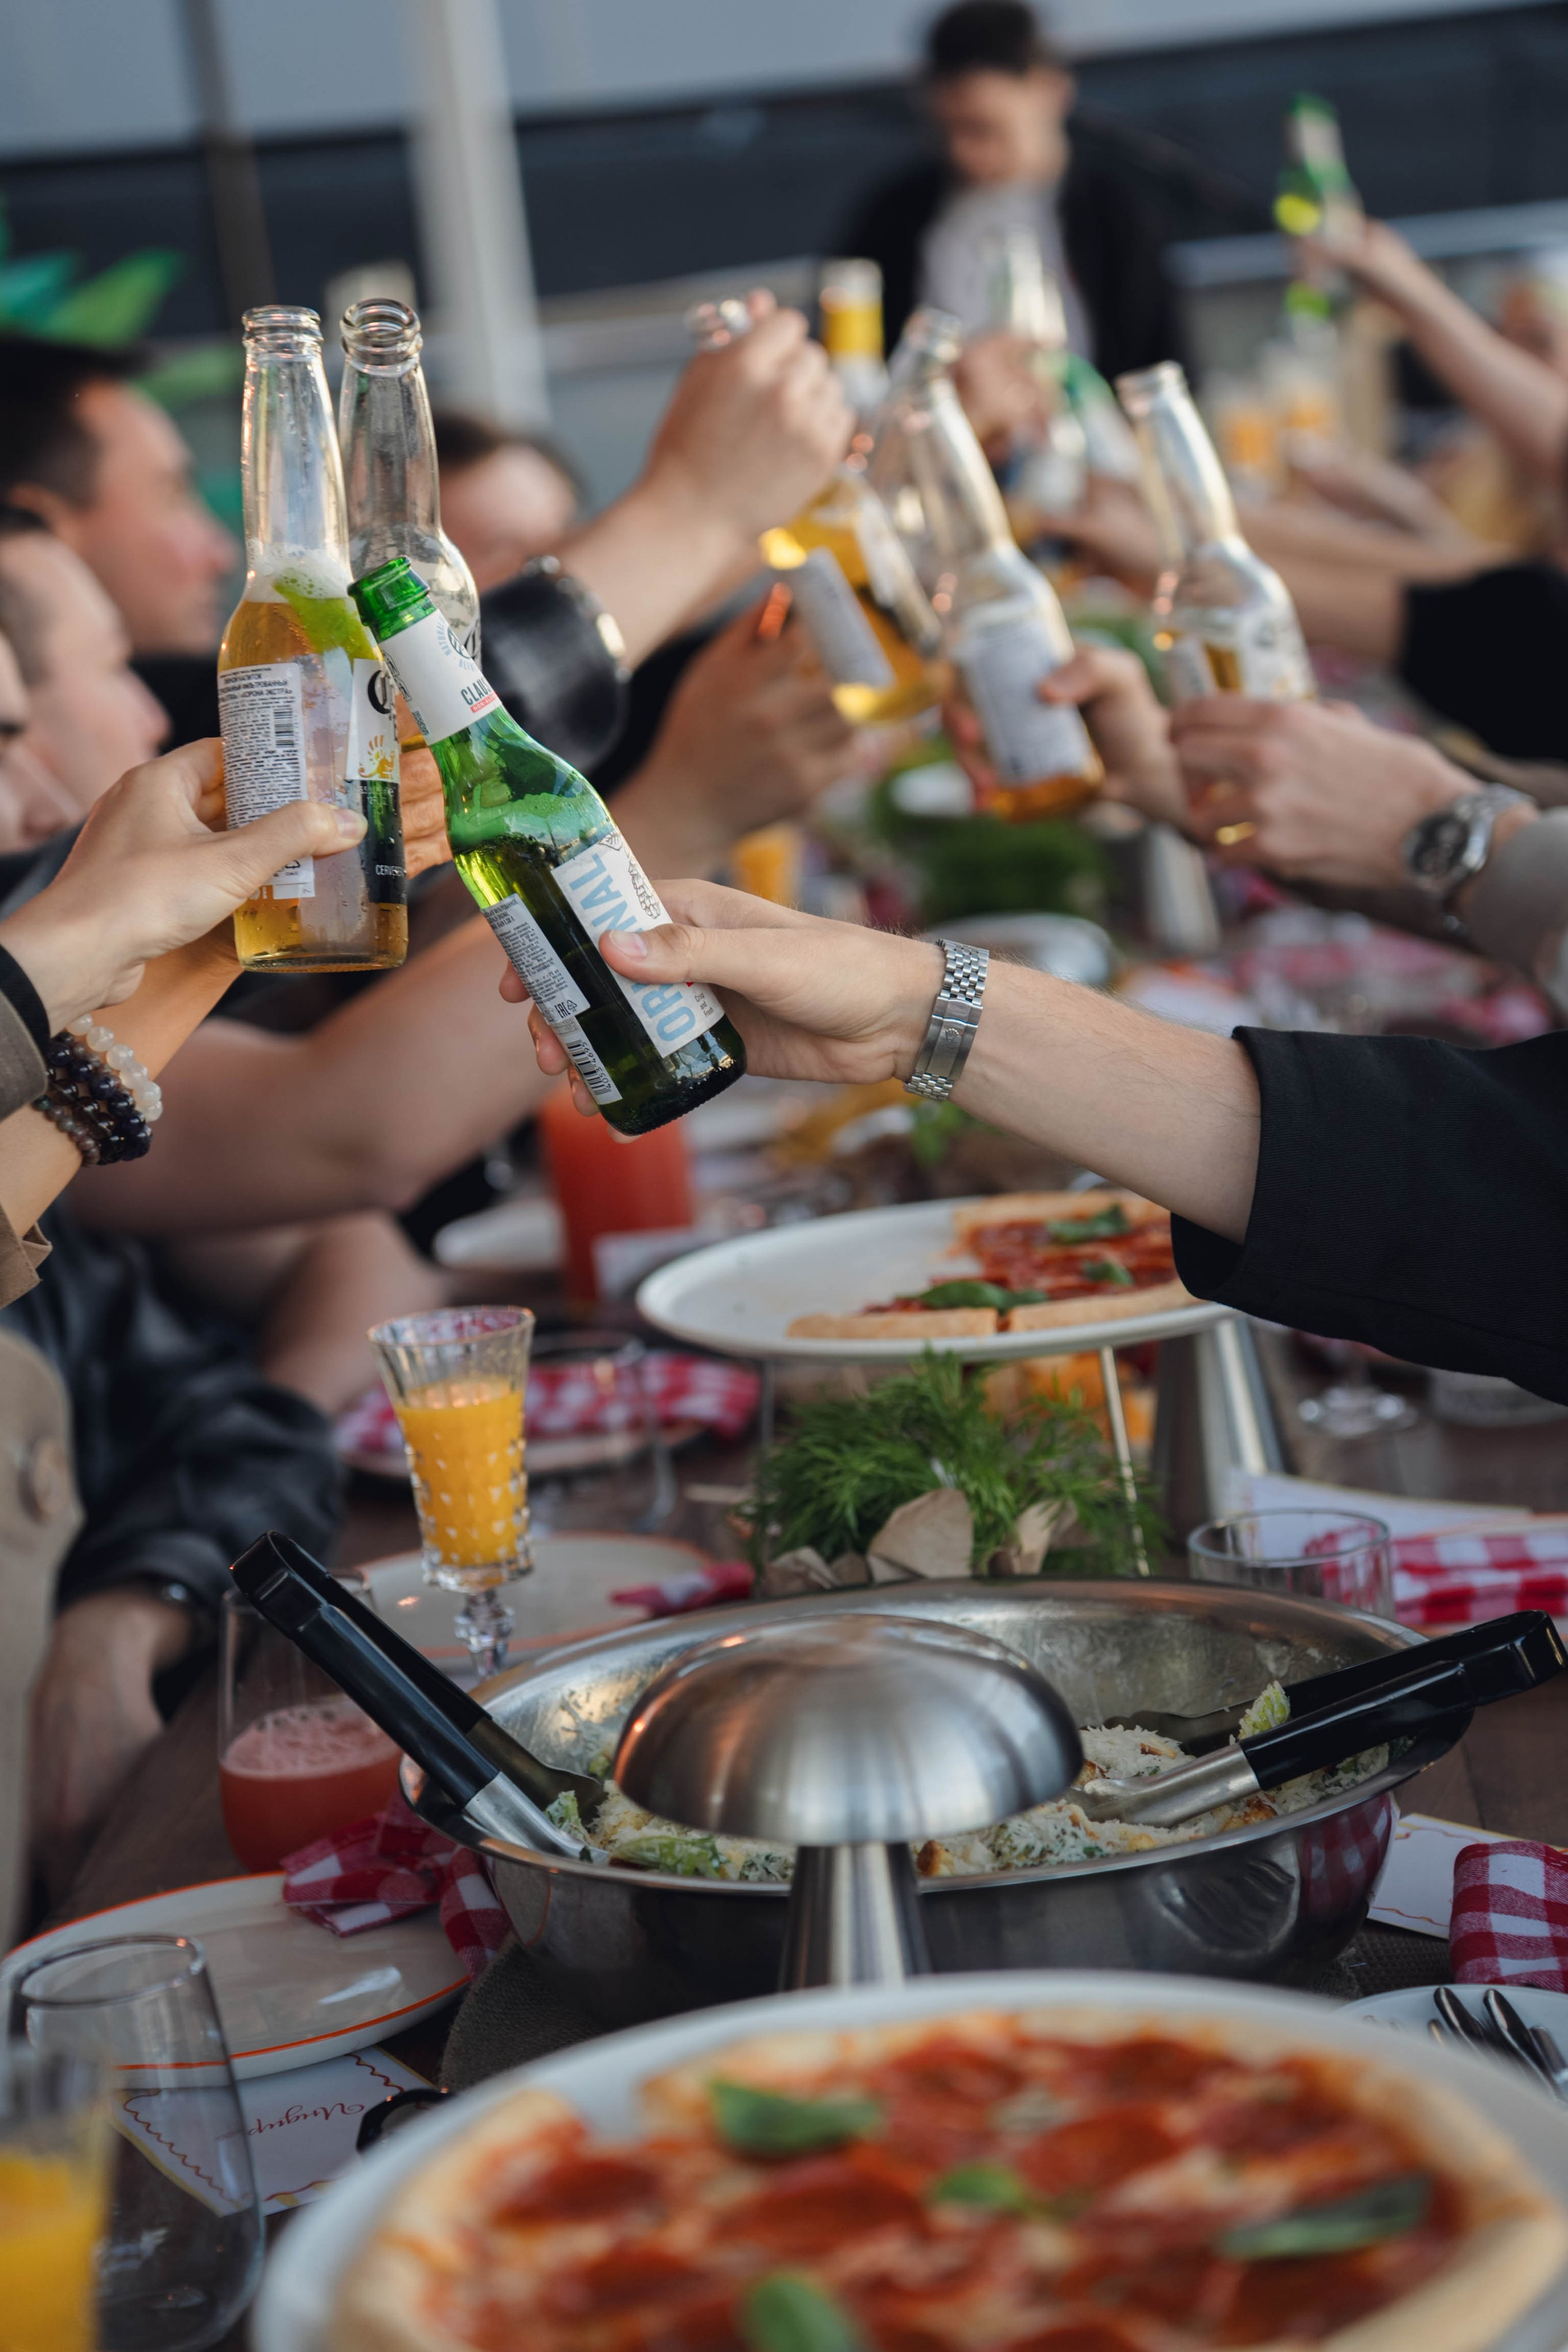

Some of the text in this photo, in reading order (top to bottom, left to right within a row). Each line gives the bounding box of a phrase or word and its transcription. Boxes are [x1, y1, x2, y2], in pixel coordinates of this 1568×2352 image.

[569, 853, 696, 1041] ORNAL
[581, 1042, 611, 1088] 4053 4695
[216, 2102, 365, 2141] Индир
